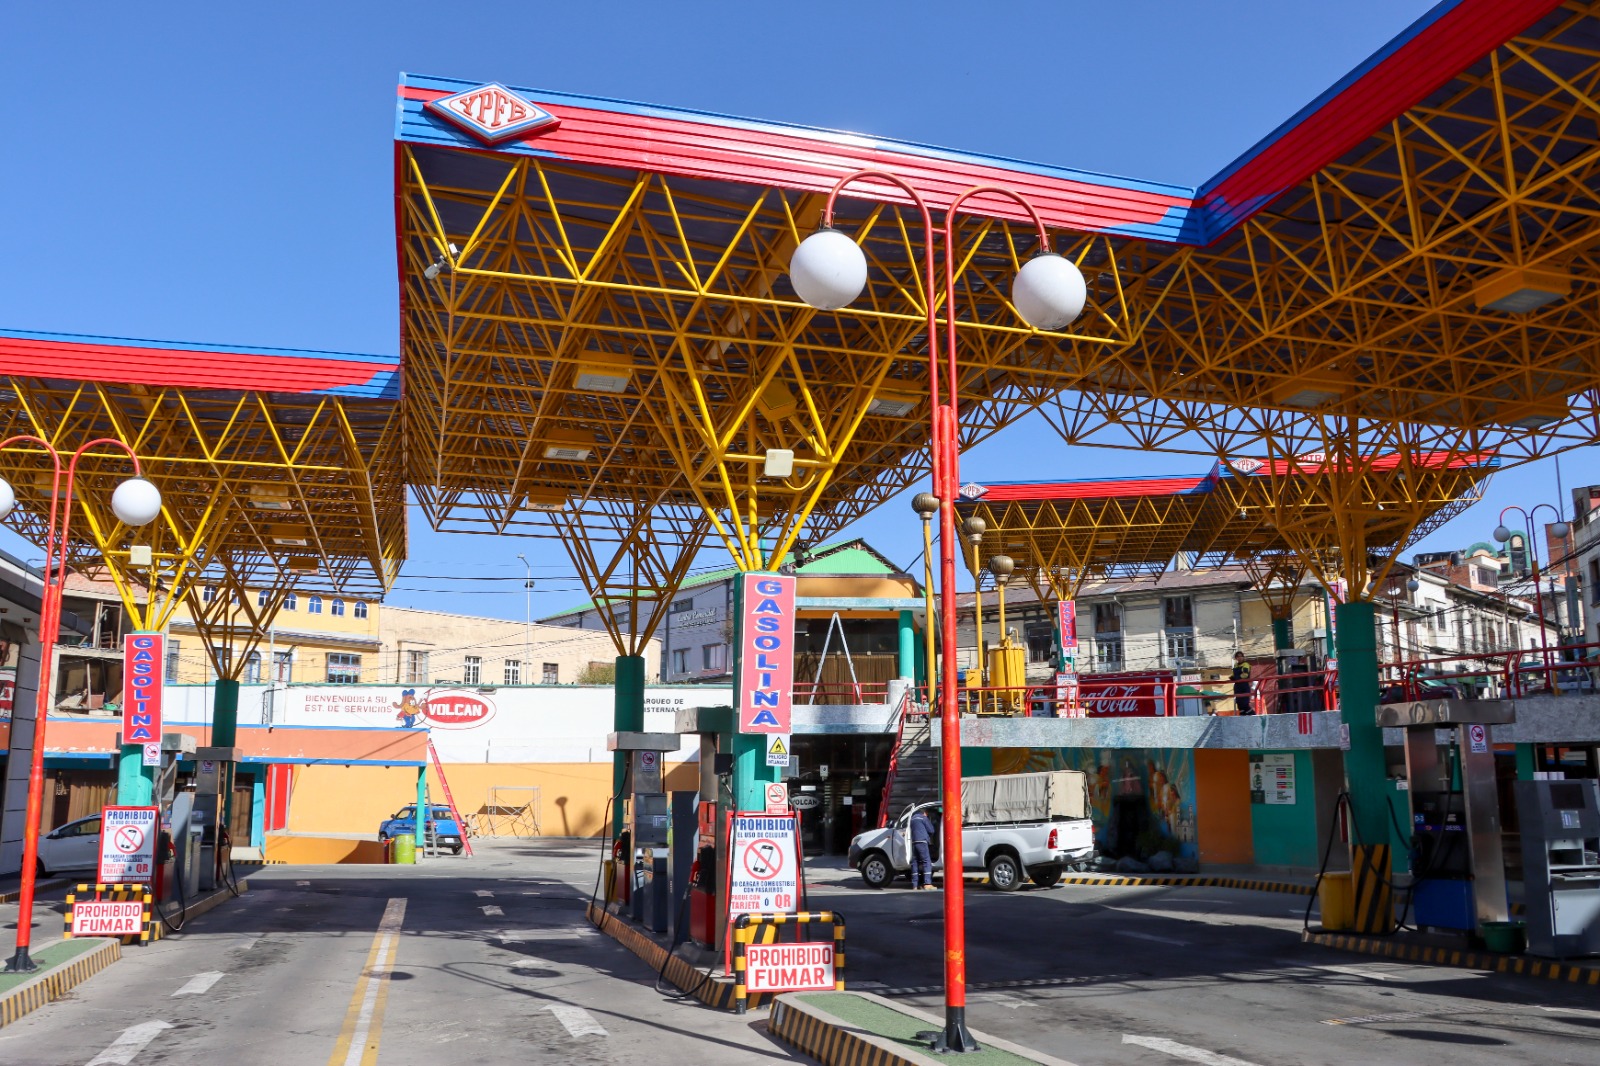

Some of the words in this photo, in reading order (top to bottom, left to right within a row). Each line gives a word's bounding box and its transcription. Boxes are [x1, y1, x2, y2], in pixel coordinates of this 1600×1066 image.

[459, 90, 527, 127] YPFB
[1237, 460, 1256, 471] YPFB
[963, 485, 981, 497] YPFB
[1063, 602, 1073, 645] GASOLINA
[748, 580, 783, 728] GASOLINA
[130, 637, 153, 739] GASOLINA
[305, 695, 364, 703] BIENVENIDOS
[375, 696, 387, 704] SU
[328, 705, 340, 713] DE
[344, 705, 393, 713] SERVICIOS
[428, 703, 483, 717] VOLCAN
[108, 811, 153, 819] PROHIBIDO
[136, 864, 148, 873] QR
[731, 901, 760, 909] TARJETA
[775, 894, 791, 909] QR
[76, 904, 140, 918] PROHIBIDO
[79, 918, 134, 931] FUMAR
[749, 947, 832, 967] PROHIBIDO
[754, 967, 826, 988] FUMAR
